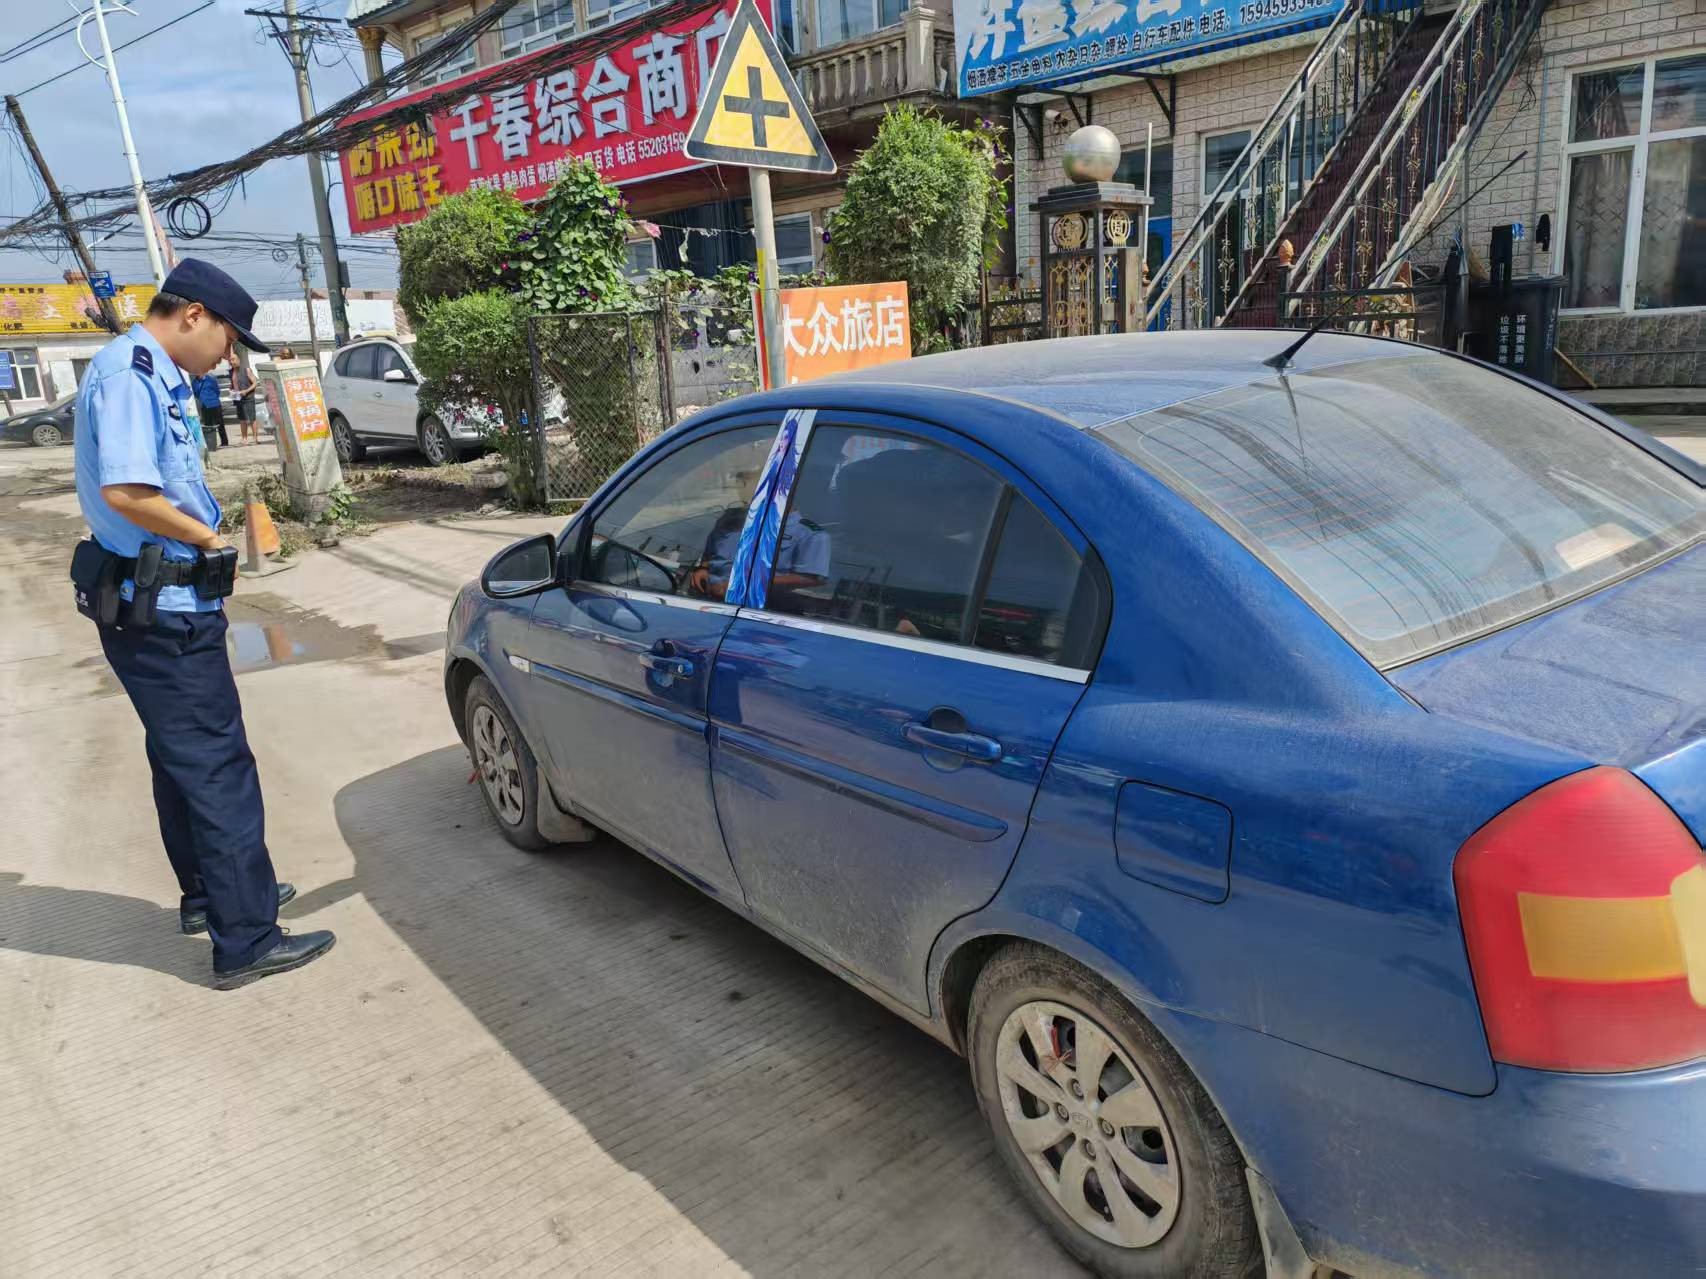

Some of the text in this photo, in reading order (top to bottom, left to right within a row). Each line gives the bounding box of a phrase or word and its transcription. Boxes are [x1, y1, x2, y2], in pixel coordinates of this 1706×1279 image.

[1105, 35, 1128, 59] 螺栓
[1131, 16, 1195, 52] 自行车配件
[617, 142, 635, 166] 电话
